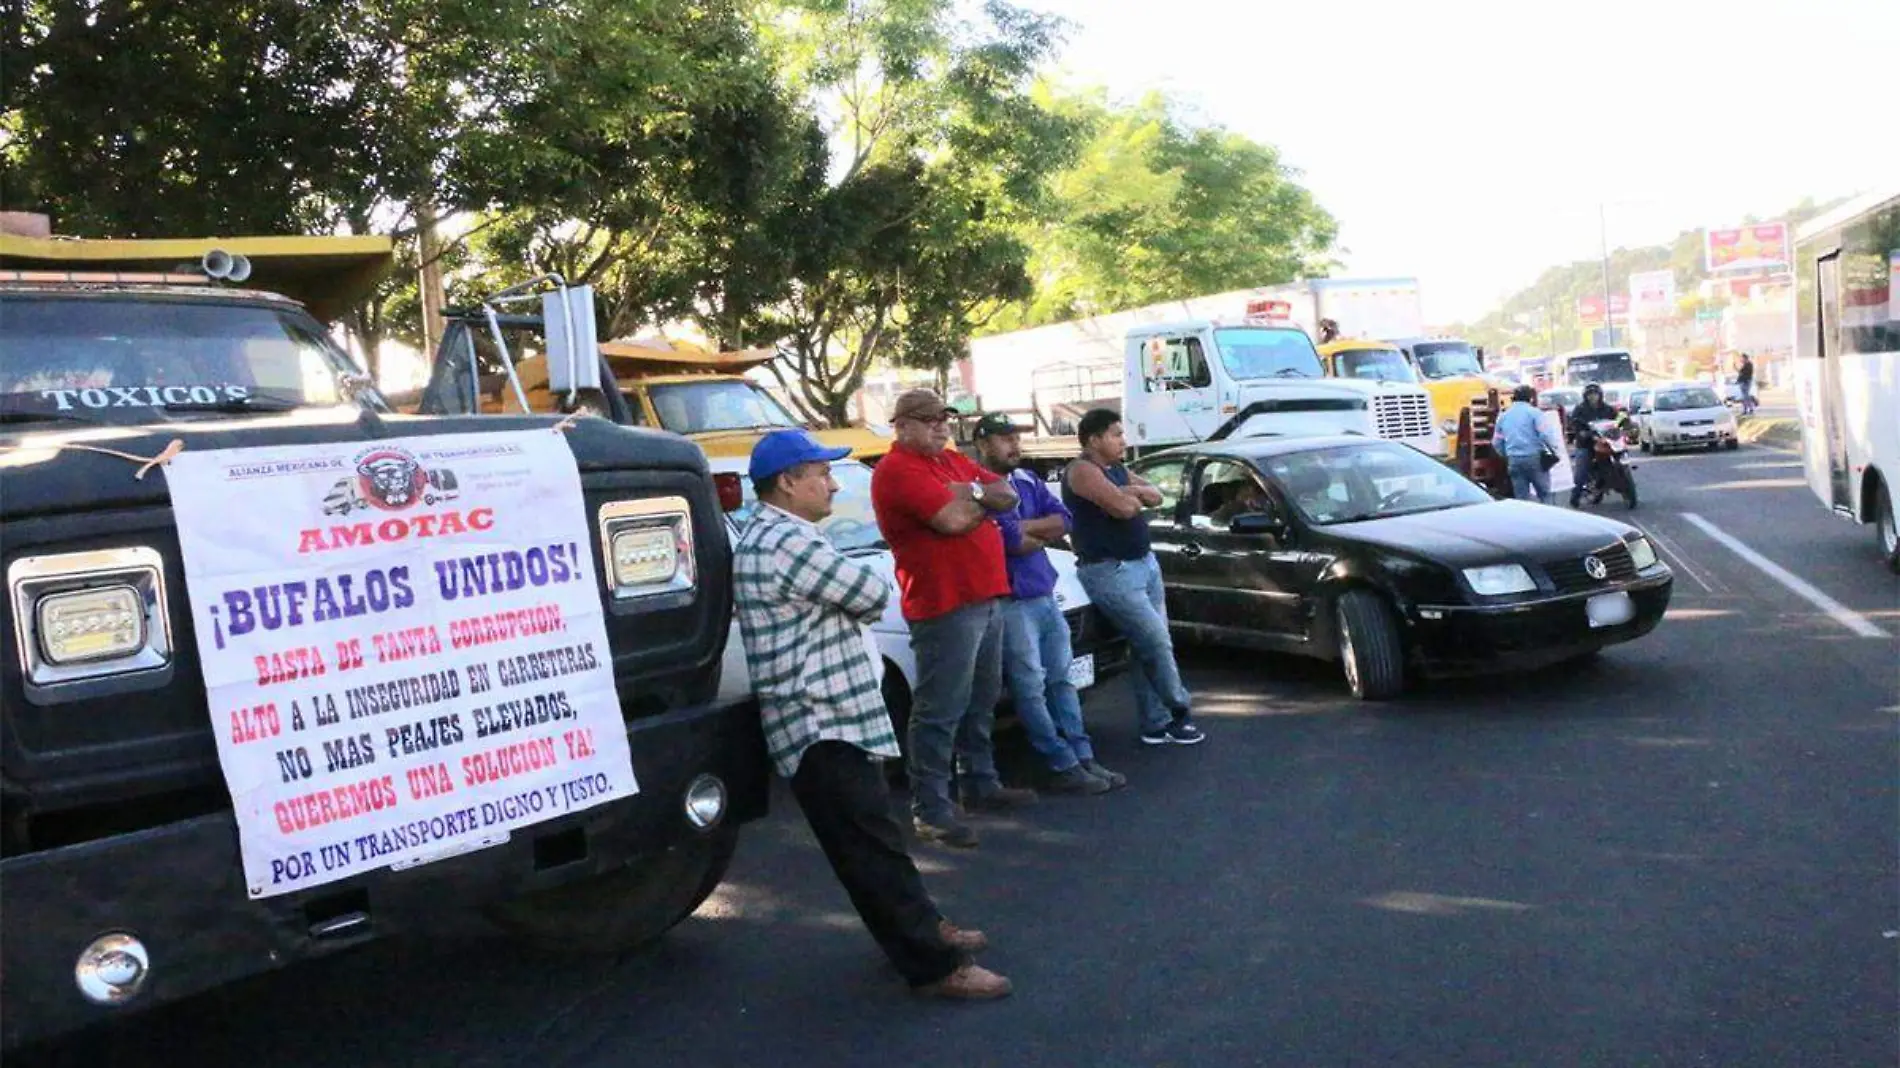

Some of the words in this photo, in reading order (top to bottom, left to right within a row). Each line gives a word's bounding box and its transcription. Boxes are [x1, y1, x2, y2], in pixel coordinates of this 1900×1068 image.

[298, 508, 495, 553] AMOTAC
[434, 542, 582, 601] UNIDOS!
[254, 646, 326, 686] BASTA
[335, 638, 364, 671] DE
[372, 625, 442, 662] TANTA
[231, 702, 281, 744] ALTO
[291, 699, 306, 732] A
[312, 693, 340, 726] LA
[345, 669, 461, 720] INSEGURIDAD
[466, 662, 492, 694] EN
[276, 746, 313, 783] NO
[322, 732, 376, 773] MAS
[385, 713, 464, 758] PEAJES
[471, 690, 578, 739] ELEVADOS,
[273, 775, 398, 835] QUEREMOS
[406, 762, 454, 800] UNA
[563, 728, 597, 760] YA!
[271, 851, 318, 884] POR
[319, 840, 351, 871] UN
[354, 806, 479, 861] TRANSPORTE
[481, 790, 544, 826] DIGNO
[545, 785, 561, 808] Y
[560, 772, 613, 811] JUSTO.
